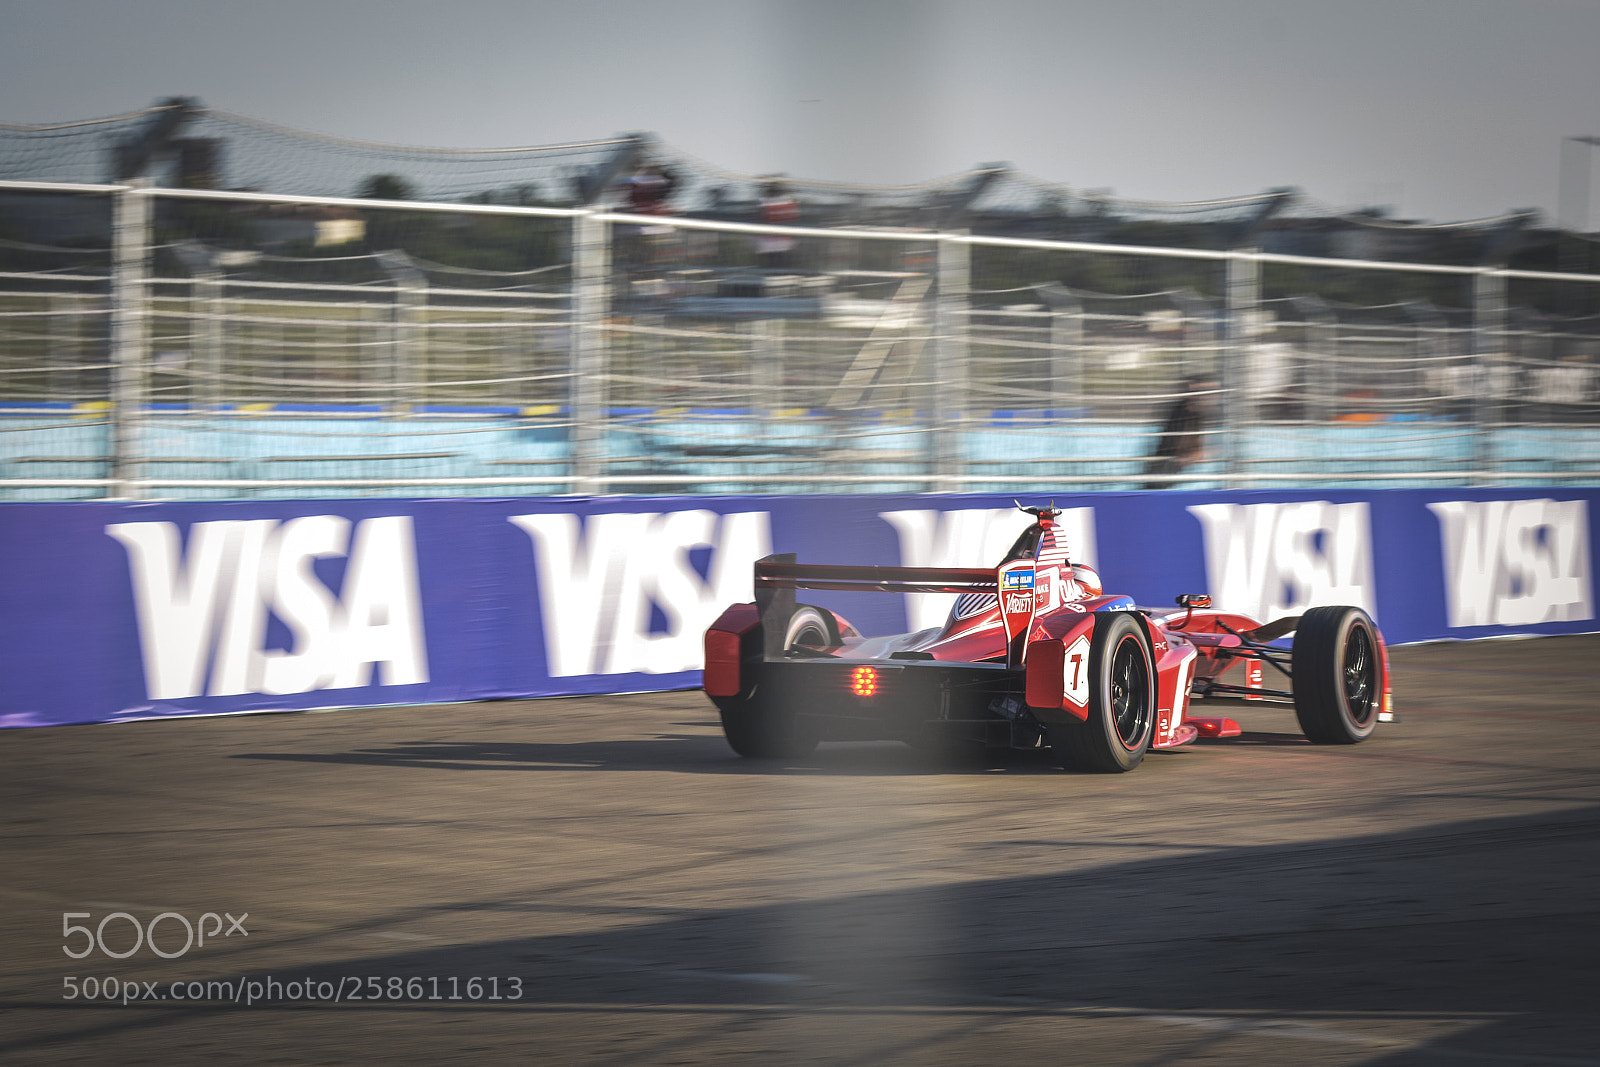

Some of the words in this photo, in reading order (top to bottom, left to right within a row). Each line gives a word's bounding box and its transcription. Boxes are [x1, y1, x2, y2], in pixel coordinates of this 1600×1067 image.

[1006, 592, 1033, 614] VARIETY
[1427, 500, 1594, 628] VISA
[105, 515, 429, 700] VISA
[1070, 653, 1082, 690] 7
